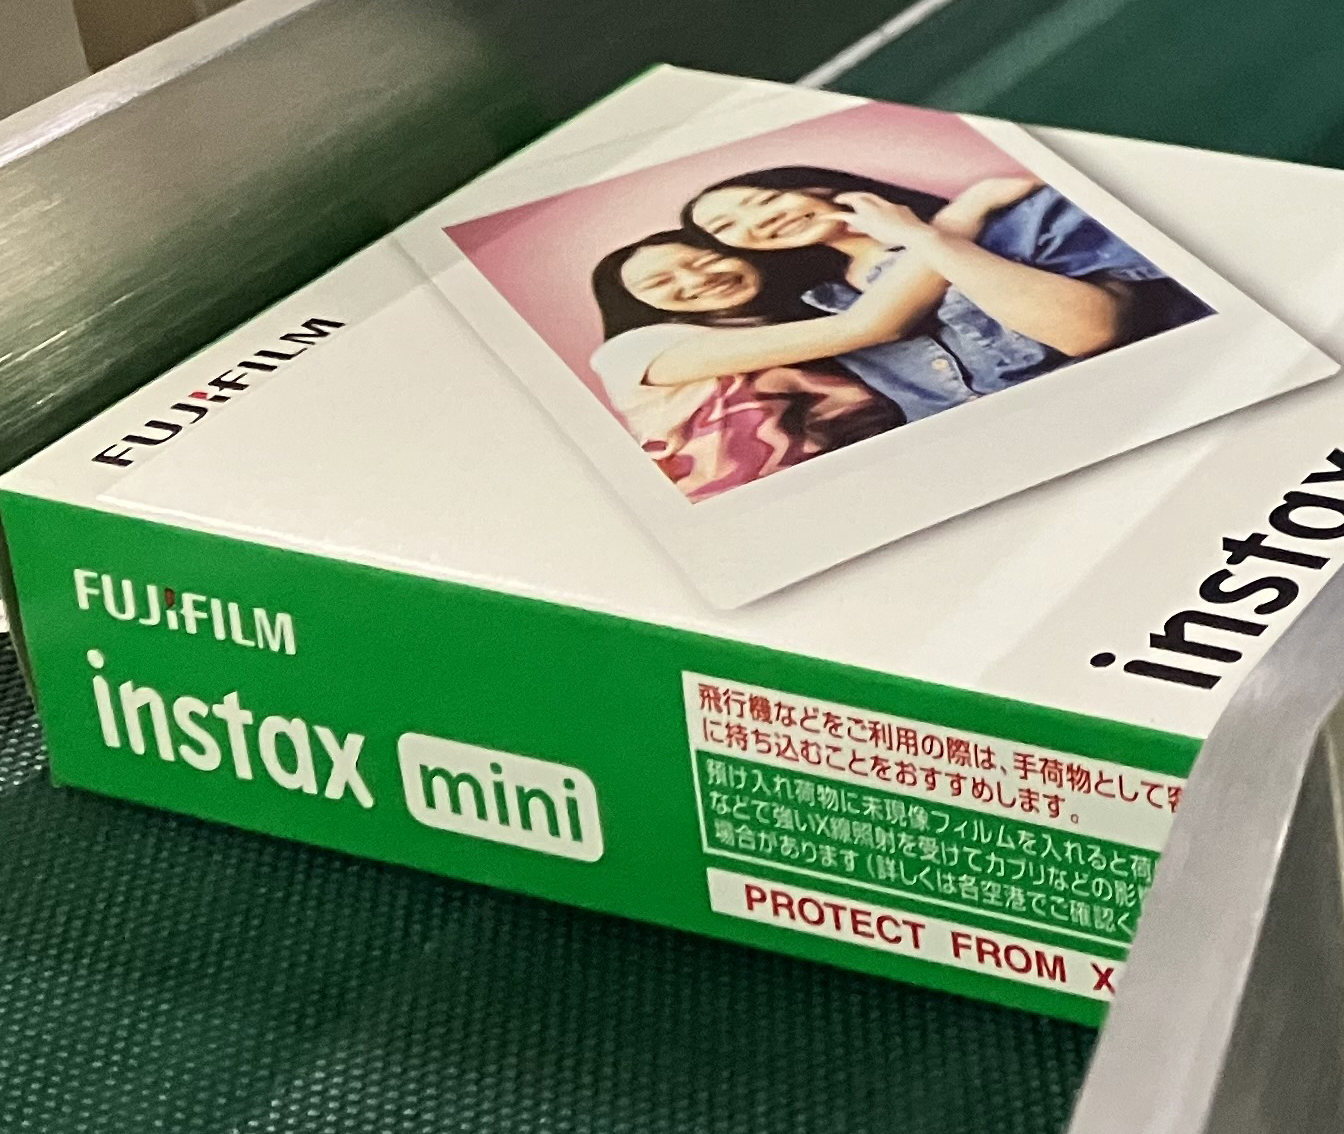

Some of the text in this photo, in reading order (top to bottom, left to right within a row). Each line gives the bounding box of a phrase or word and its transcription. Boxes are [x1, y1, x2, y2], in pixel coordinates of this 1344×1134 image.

[92, 317, 346, 468] FUJIFILM
[74, 569, 297, 655] FUJIFILM
[87, 650, 586, 843] instax mini
[706, 758, 1157, 882] 預け入れ荷物に未現像フィルムを入れると荷
[744, 883, 926, 951] PROTECT
[950, 930, 1067, 984] FROM
